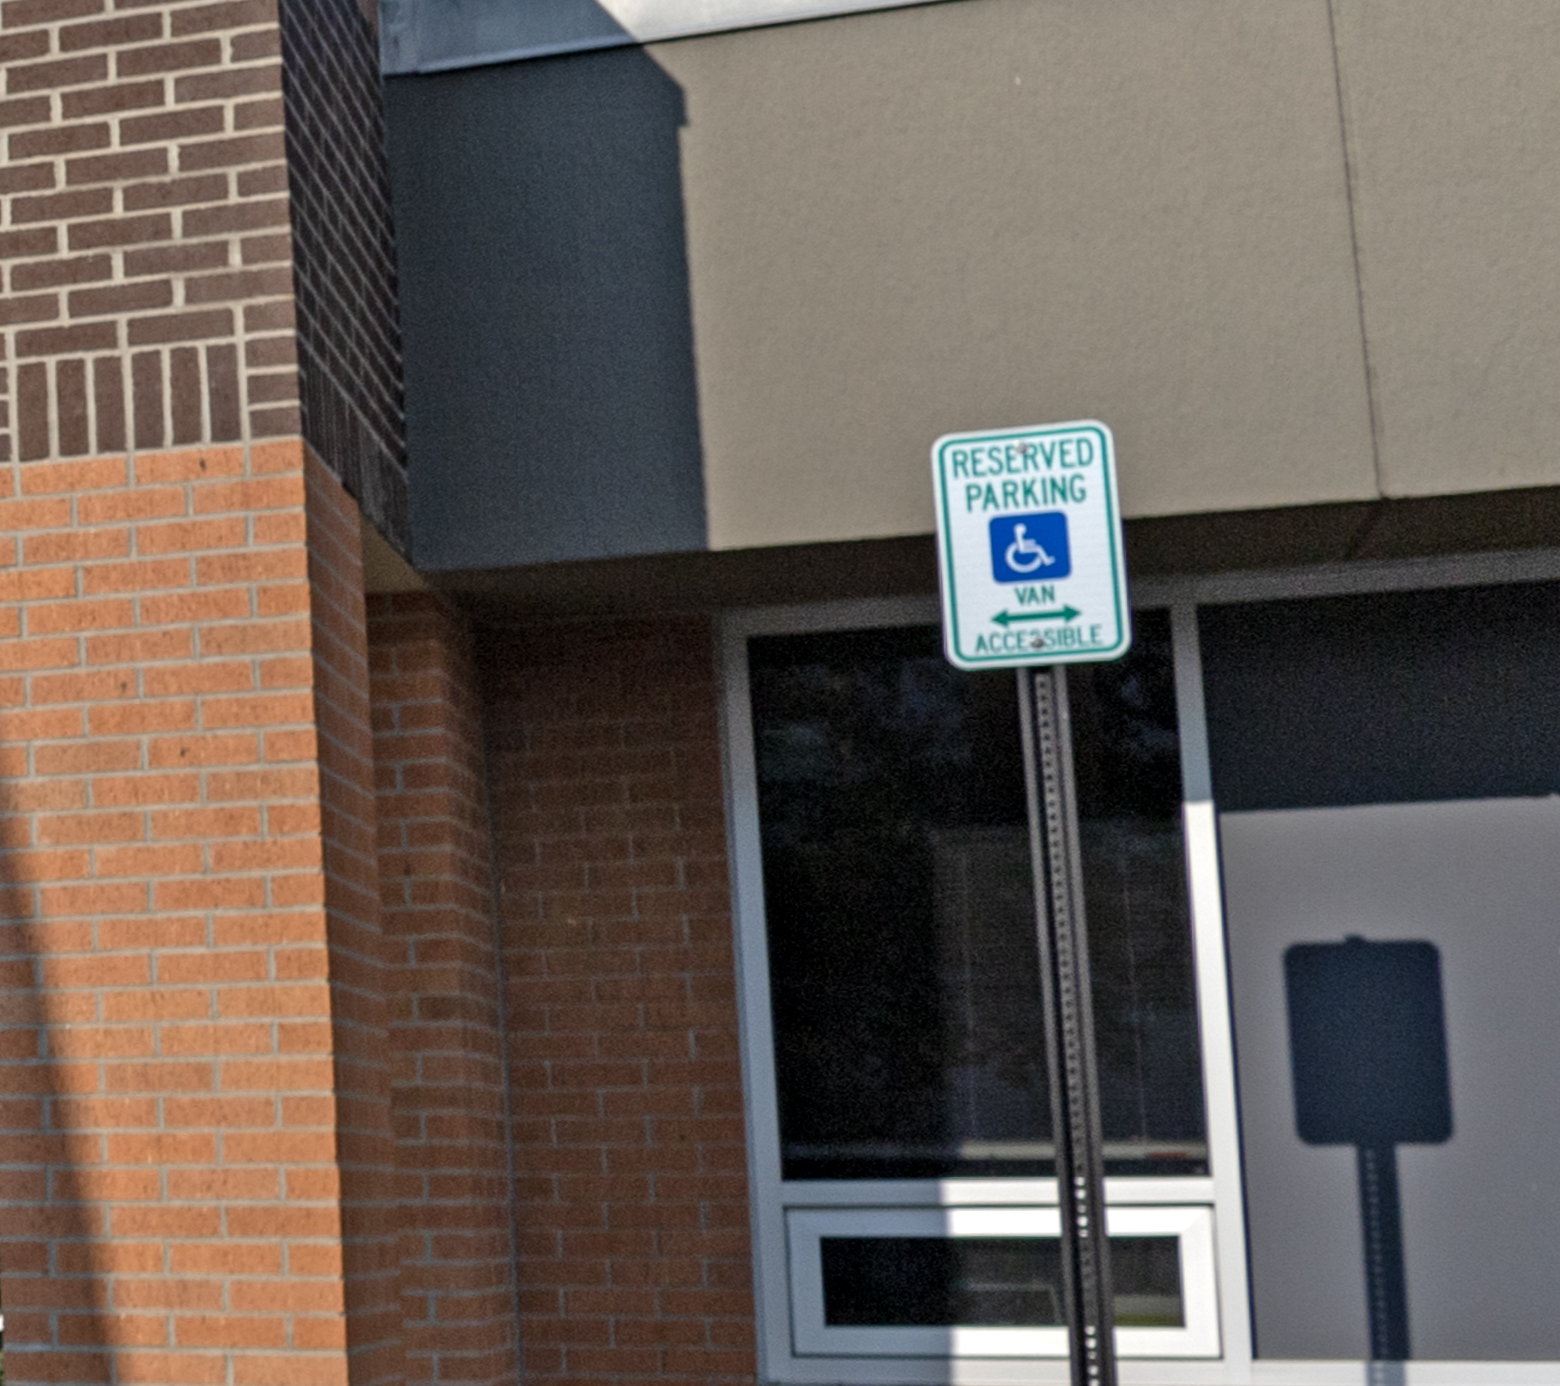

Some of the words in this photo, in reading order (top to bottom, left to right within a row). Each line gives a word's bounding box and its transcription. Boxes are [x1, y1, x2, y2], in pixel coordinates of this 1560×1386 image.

[951, 437, 1094, 479] RESERVED
[965, 473, 1087, 512] PARKING
[1014, 584, 1056, 606] VAN
